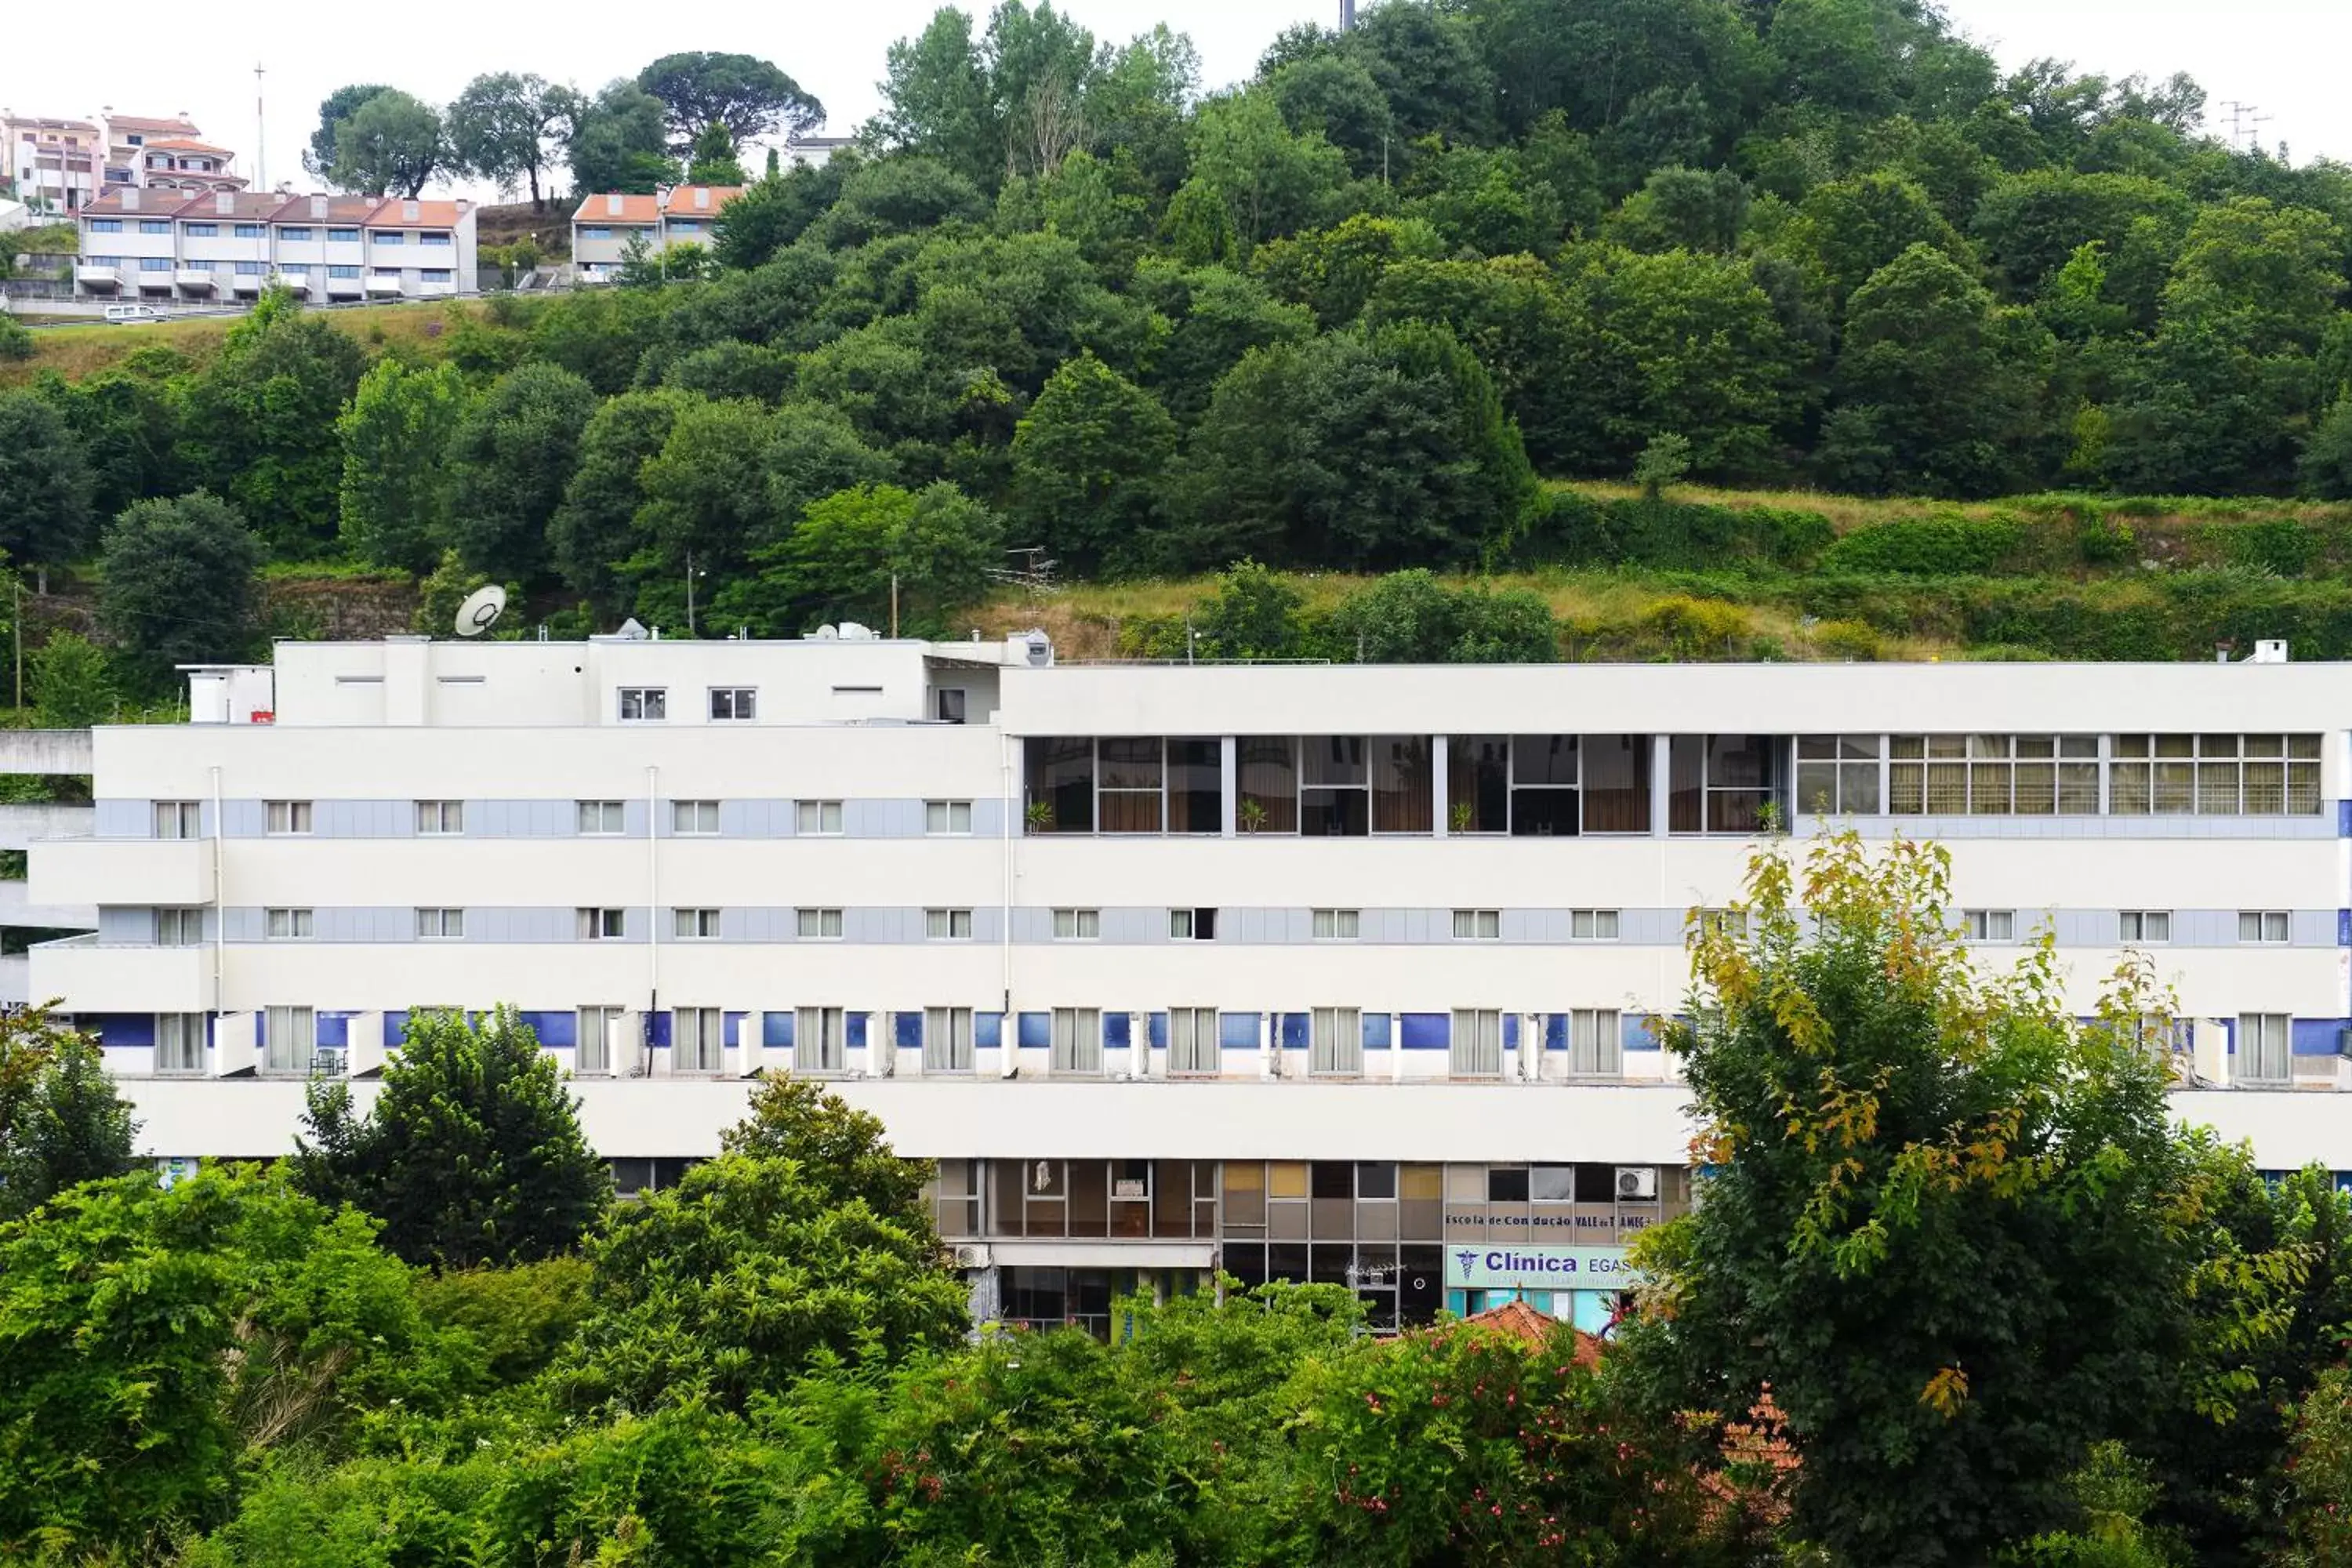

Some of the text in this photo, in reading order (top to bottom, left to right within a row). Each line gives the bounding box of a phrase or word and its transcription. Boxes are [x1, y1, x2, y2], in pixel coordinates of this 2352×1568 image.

[1445, 1214, 1484, 1224] Escola
[1489, 1216, 1502, 1225] de
[1575, 1216, 1597, 1227] VALE
[1486, 1252, 1577, 1272] Clínica
